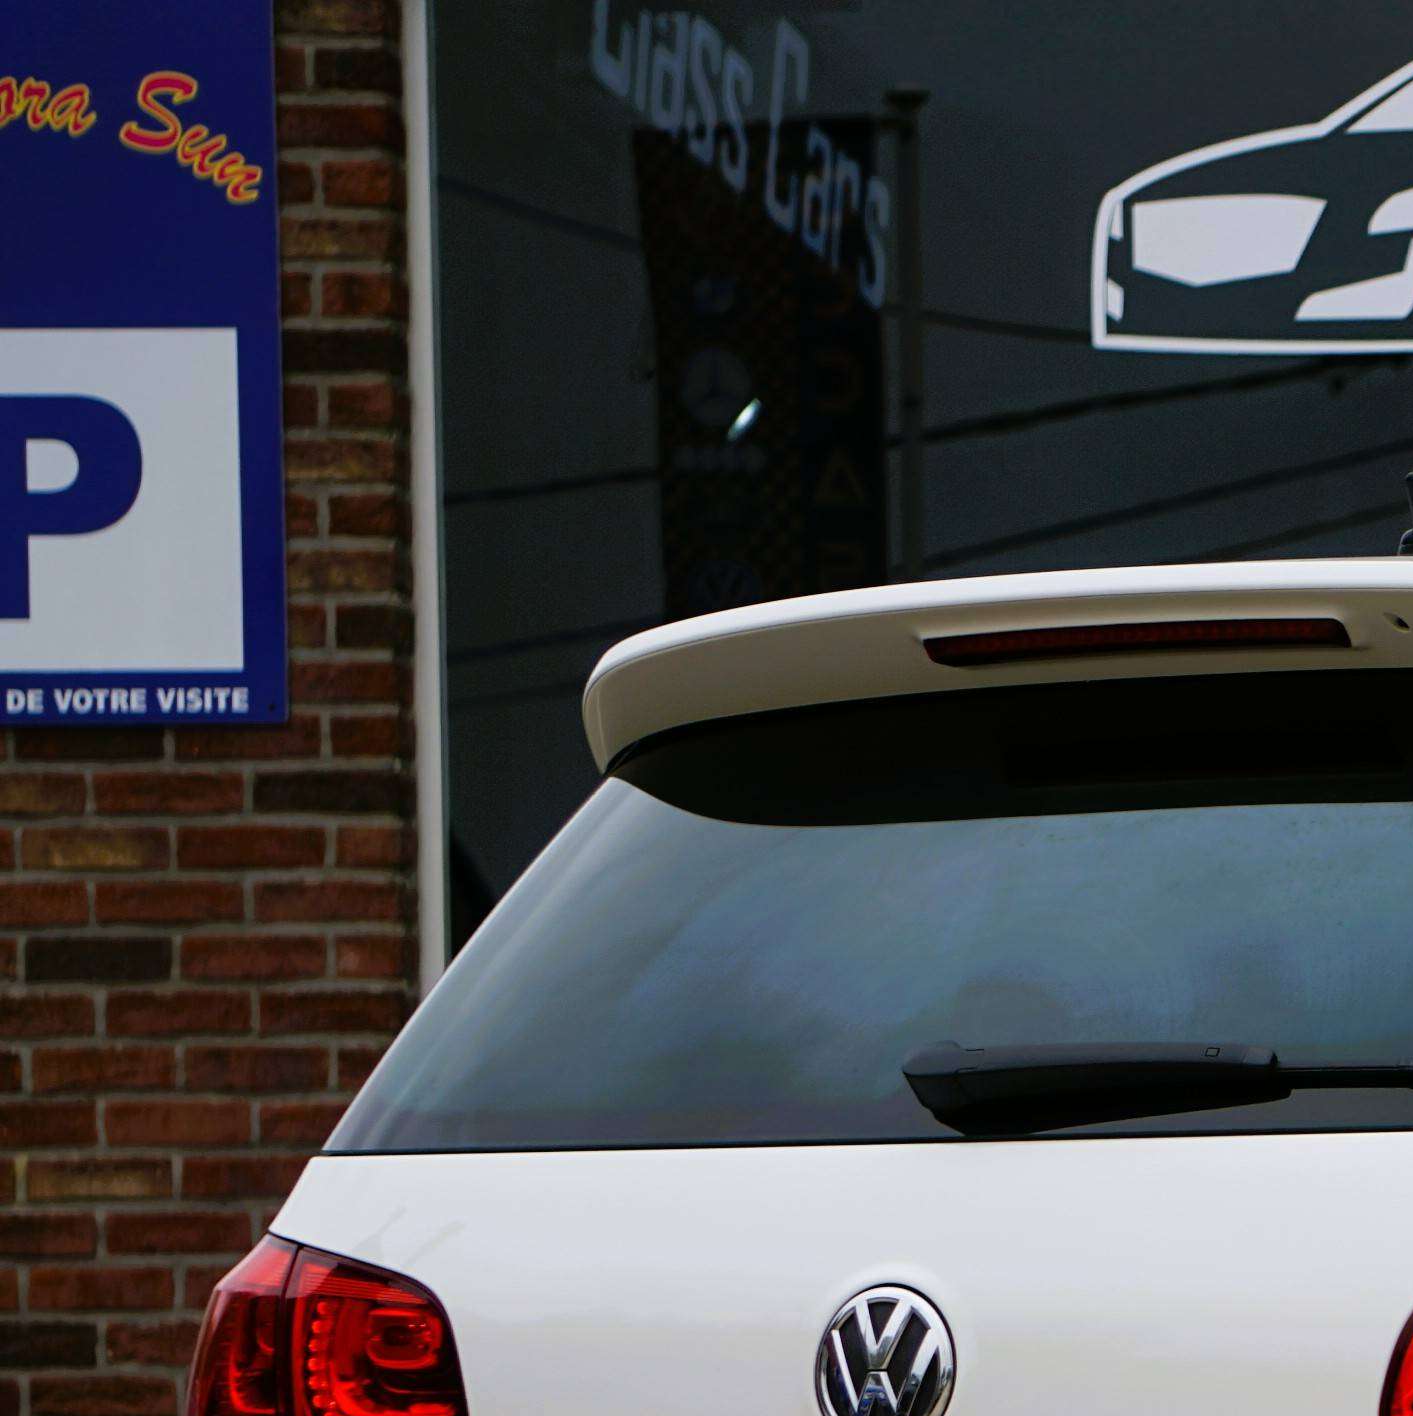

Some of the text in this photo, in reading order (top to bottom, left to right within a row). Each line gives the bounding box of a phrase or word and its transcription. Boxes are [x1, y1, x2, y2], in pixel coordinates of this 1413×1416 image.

[118, 70, 263, 205] Sun
[0, 394, 142, 619] P
[5, 686, 249, 715] DE VOTRE VISITE
